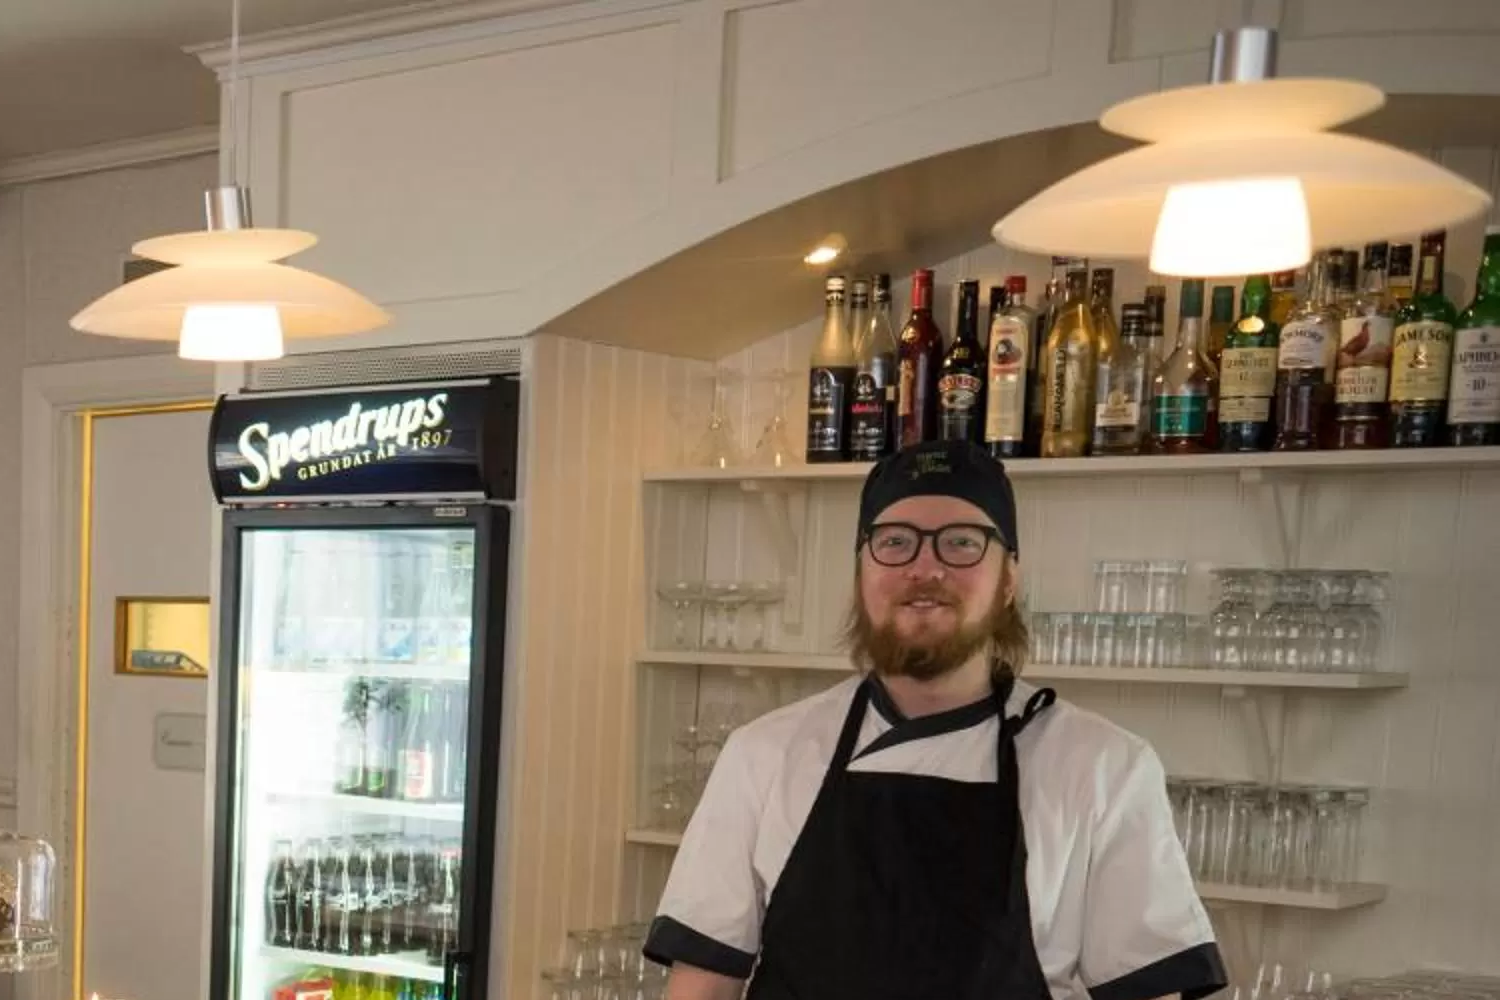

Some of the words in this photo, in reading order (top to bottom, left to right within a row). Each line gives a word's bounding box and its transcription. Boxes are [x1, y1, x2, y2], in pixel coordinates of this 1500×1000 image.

[238, 393, 448, 491] Spendrups
[298, 453, 372, 481] GRUNDAT
[411, 429, 453, 451] 1897
